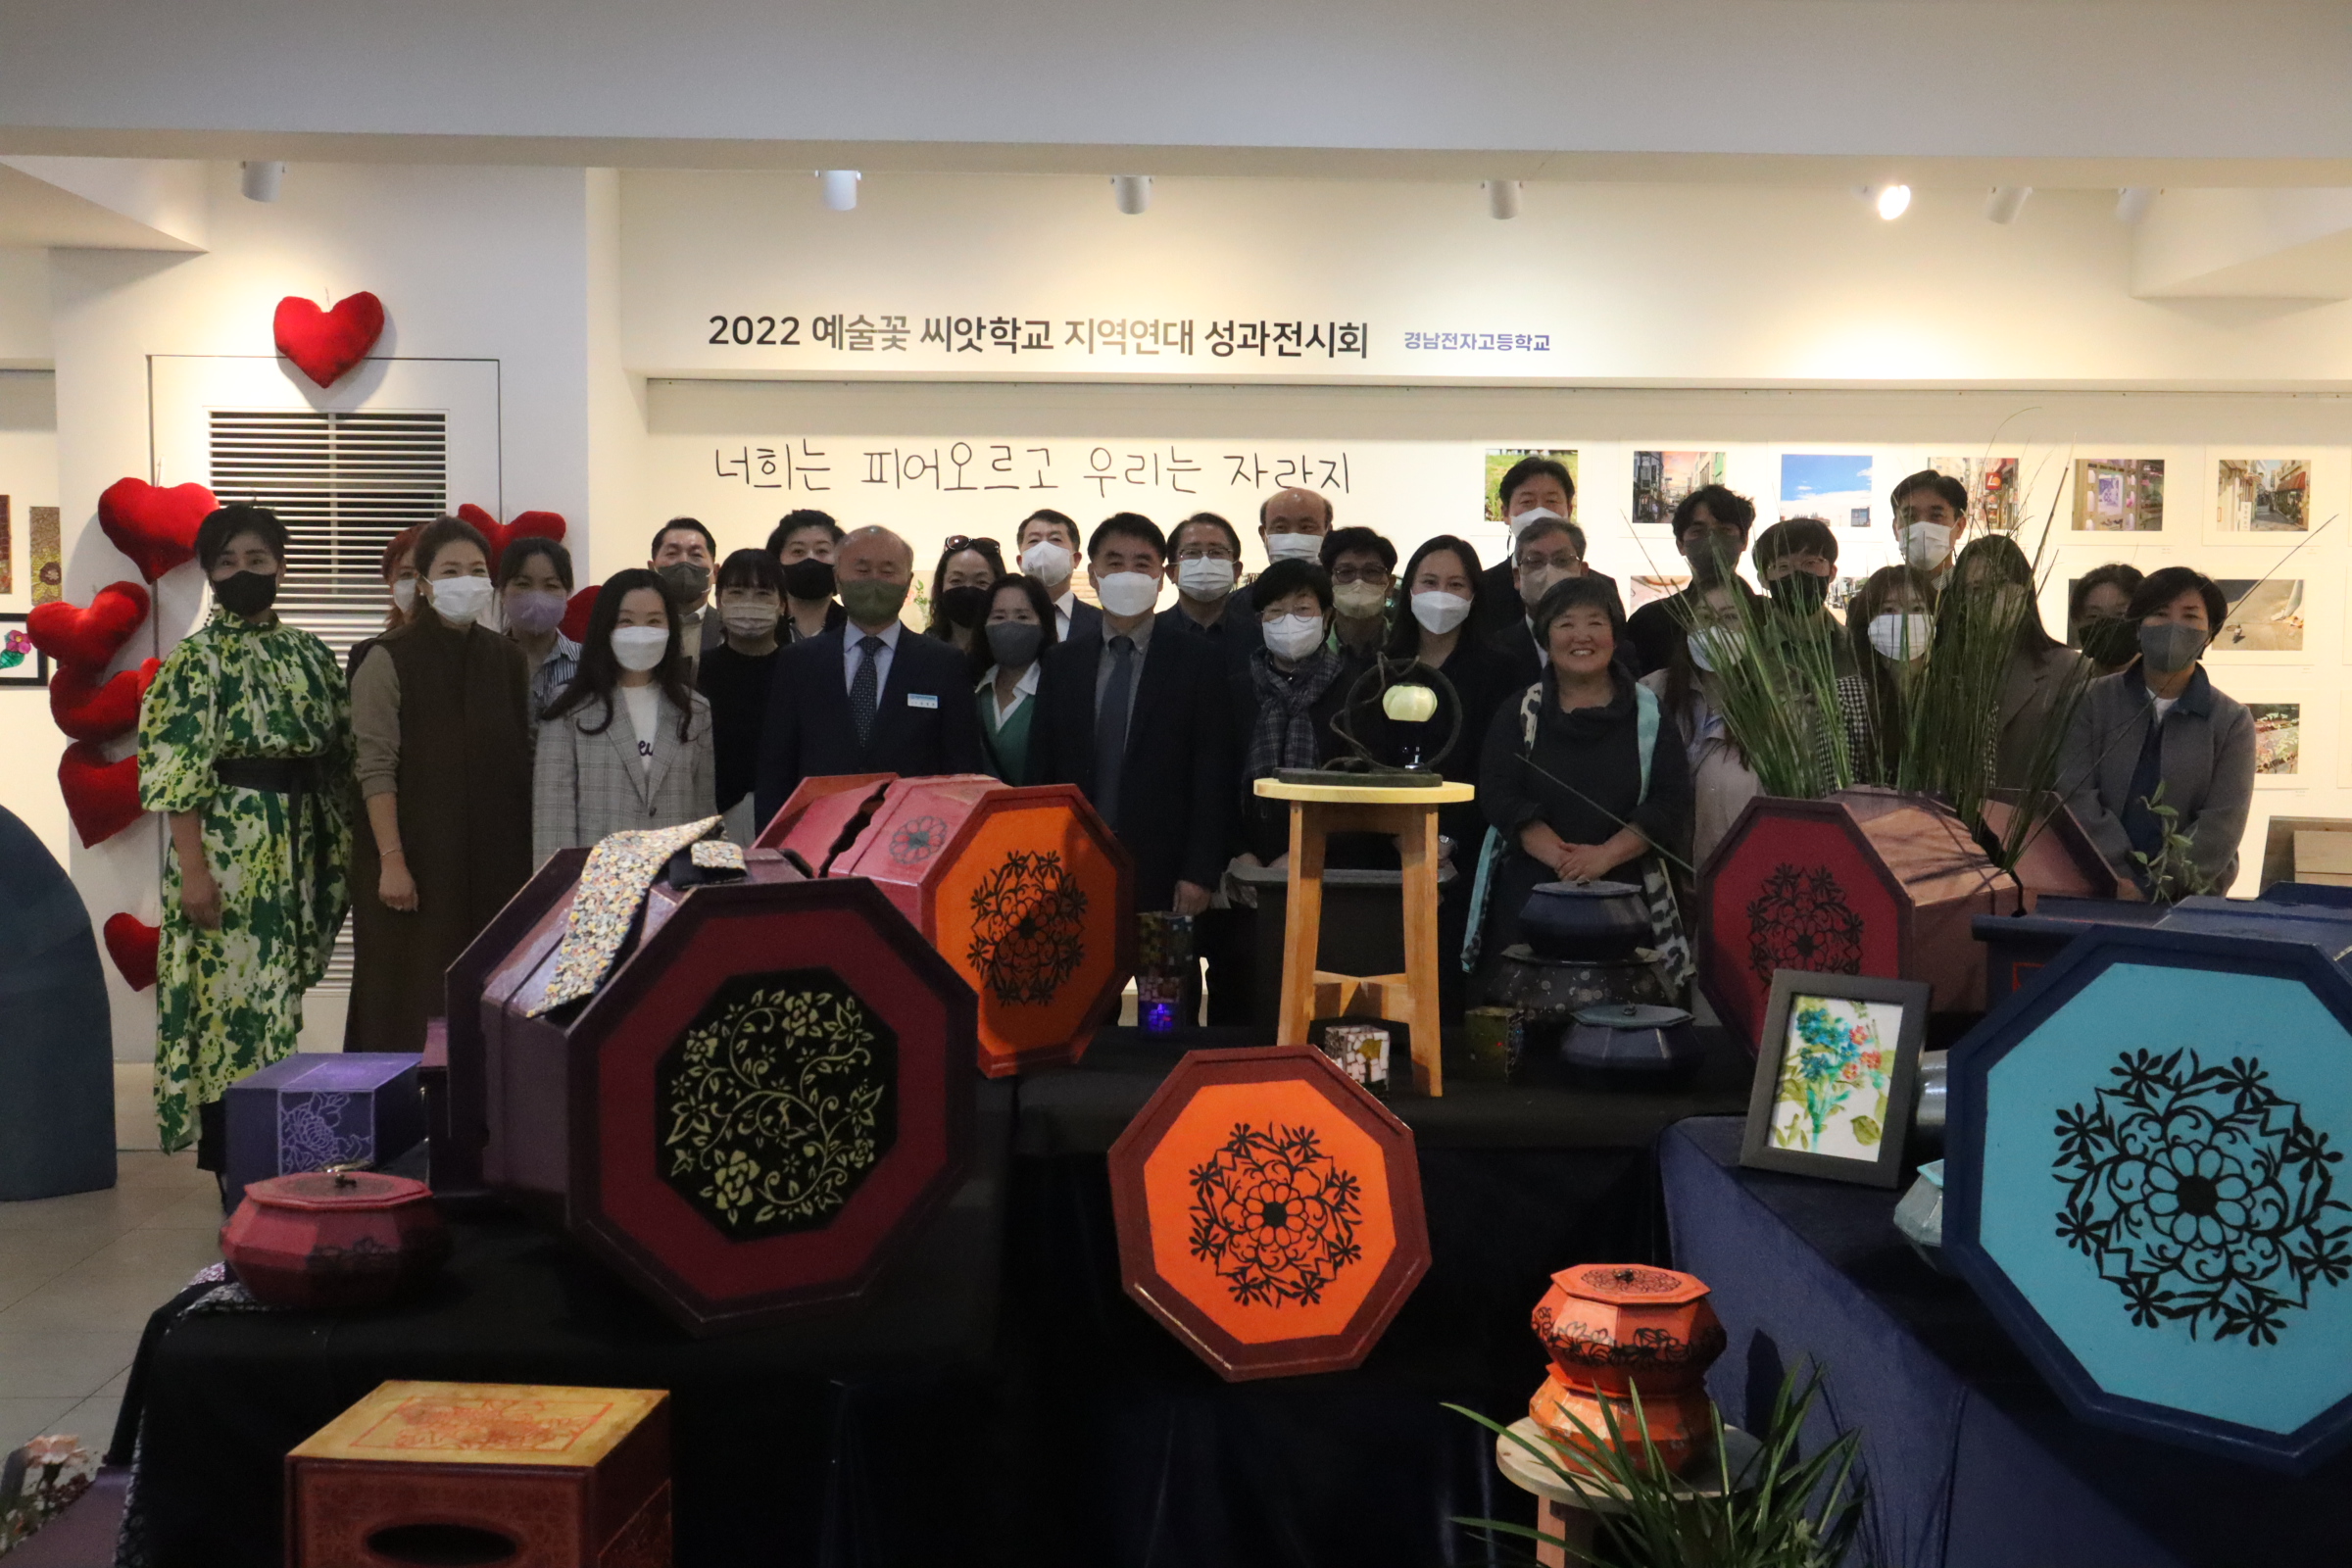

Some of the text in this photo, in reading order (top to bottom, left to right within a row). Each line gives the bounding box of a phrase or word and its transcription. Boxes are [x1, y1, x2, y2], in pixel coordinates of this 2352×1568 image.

[709, 314, 1368, 360] 2022 예술꽃 씨앗학교 지역연대 성과전시회
[1404, 331, 1550, 352] 경남전자고등학교
[715, 438, 1349, 499] 너희는 피어오르고 우리는 자라지
